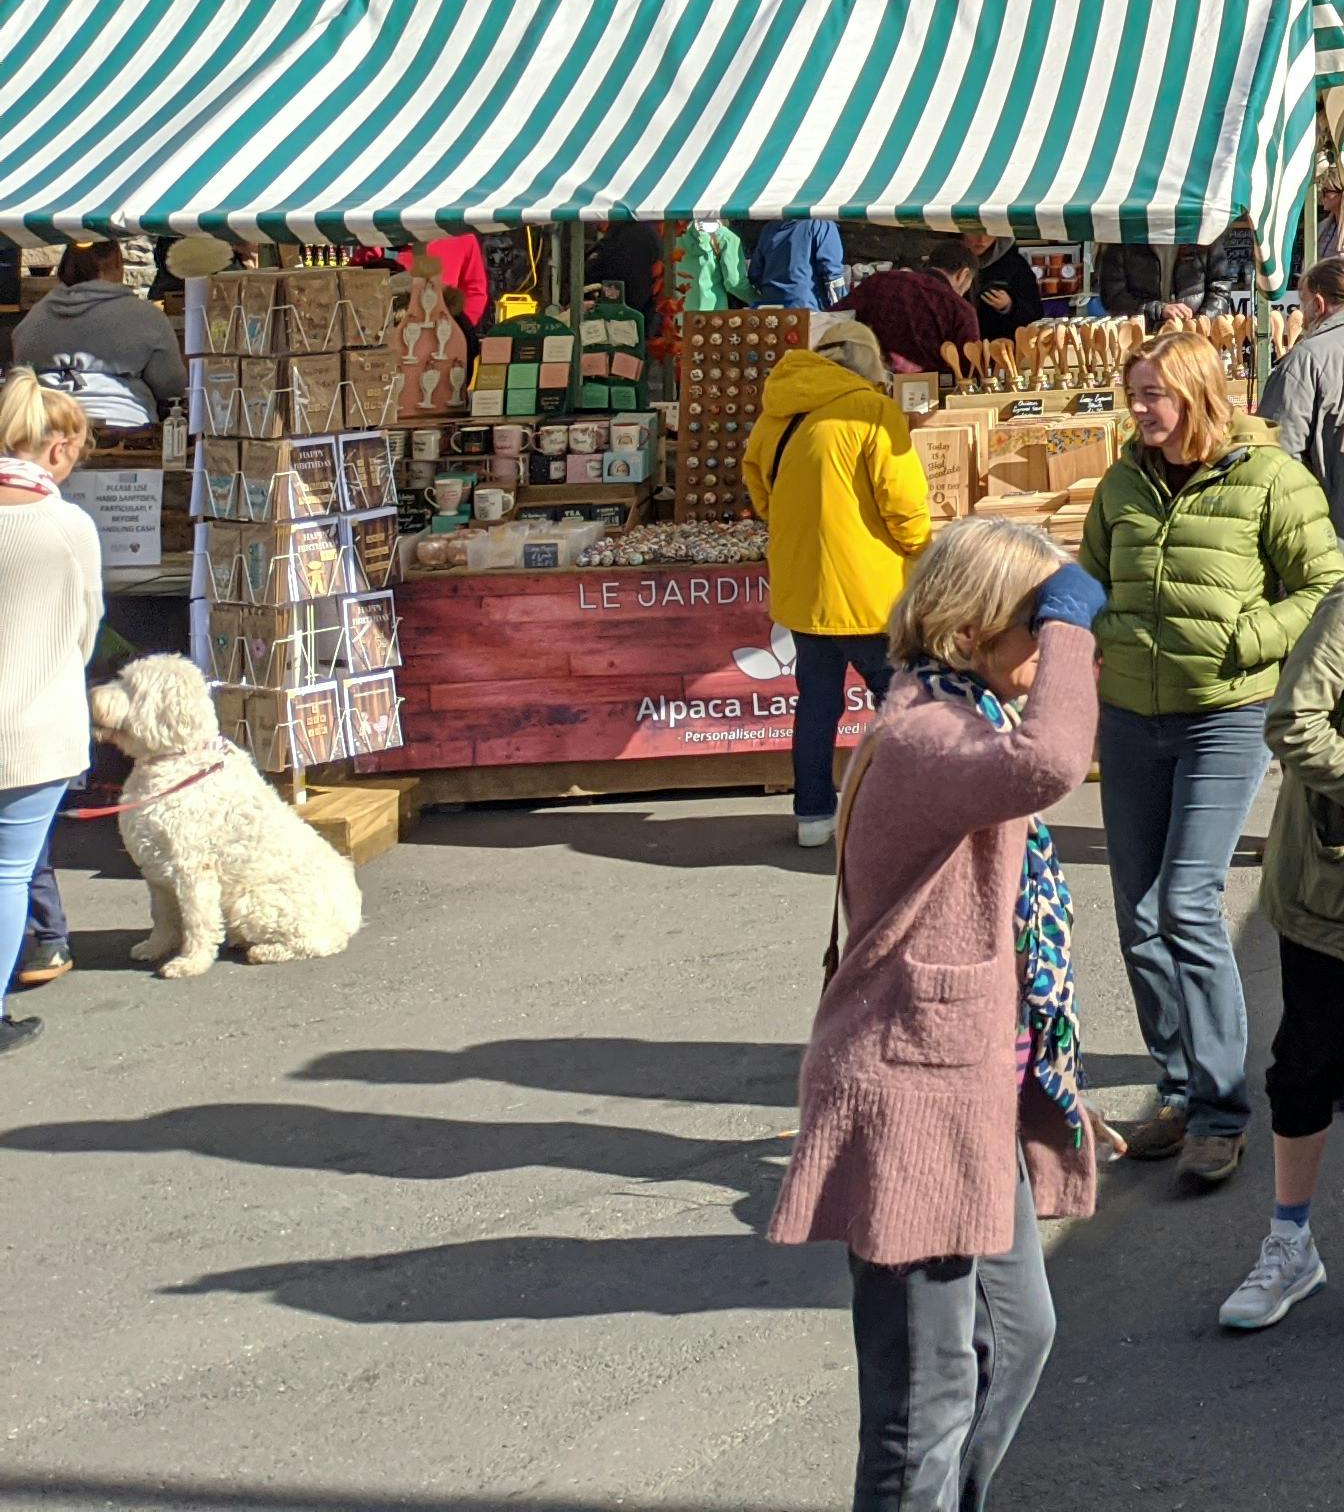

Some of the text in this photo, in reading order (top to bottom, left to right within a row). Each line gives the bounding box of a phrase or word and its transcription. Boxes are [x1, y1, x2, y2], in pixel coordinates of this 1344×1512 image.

[927, 442, 950, 452] Today
[299, 449, 324, 460] HAPPY
[293, 458, 332, 470] BIRTHDAY
[928, 464, 961, 479] ocolate
[106, 484, 131, 492] PLEASE
[100, 505, 152, 513] PARTICULARLY
[135, 525, 156, 533] CASH
[578, 576, 771, 609] LE JARDIN
[636, 686, 875, 728] Alpaca Las St
[684, 723, 860, 743] Personalised lase ved
